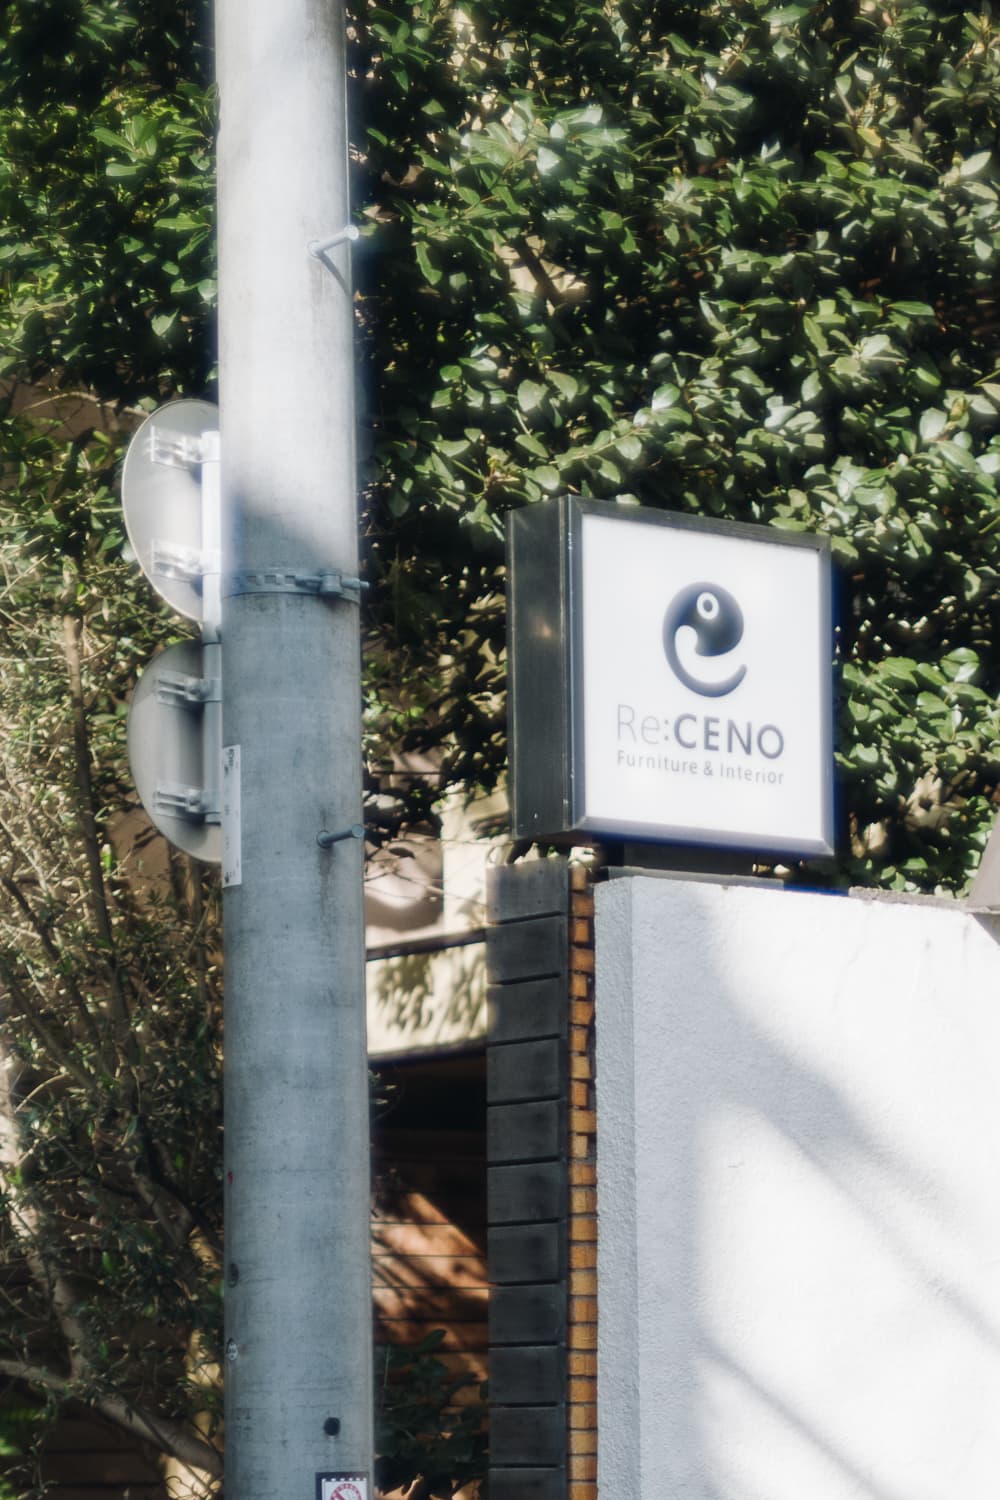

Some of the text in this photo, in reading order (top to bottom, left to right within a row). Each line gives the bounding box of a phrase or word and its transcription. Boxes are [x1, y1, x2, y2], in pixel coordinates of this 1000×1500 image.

[616, 704, 785, 760] Re:CENO
[617, 750, 785, 785] Furniture & Interior
